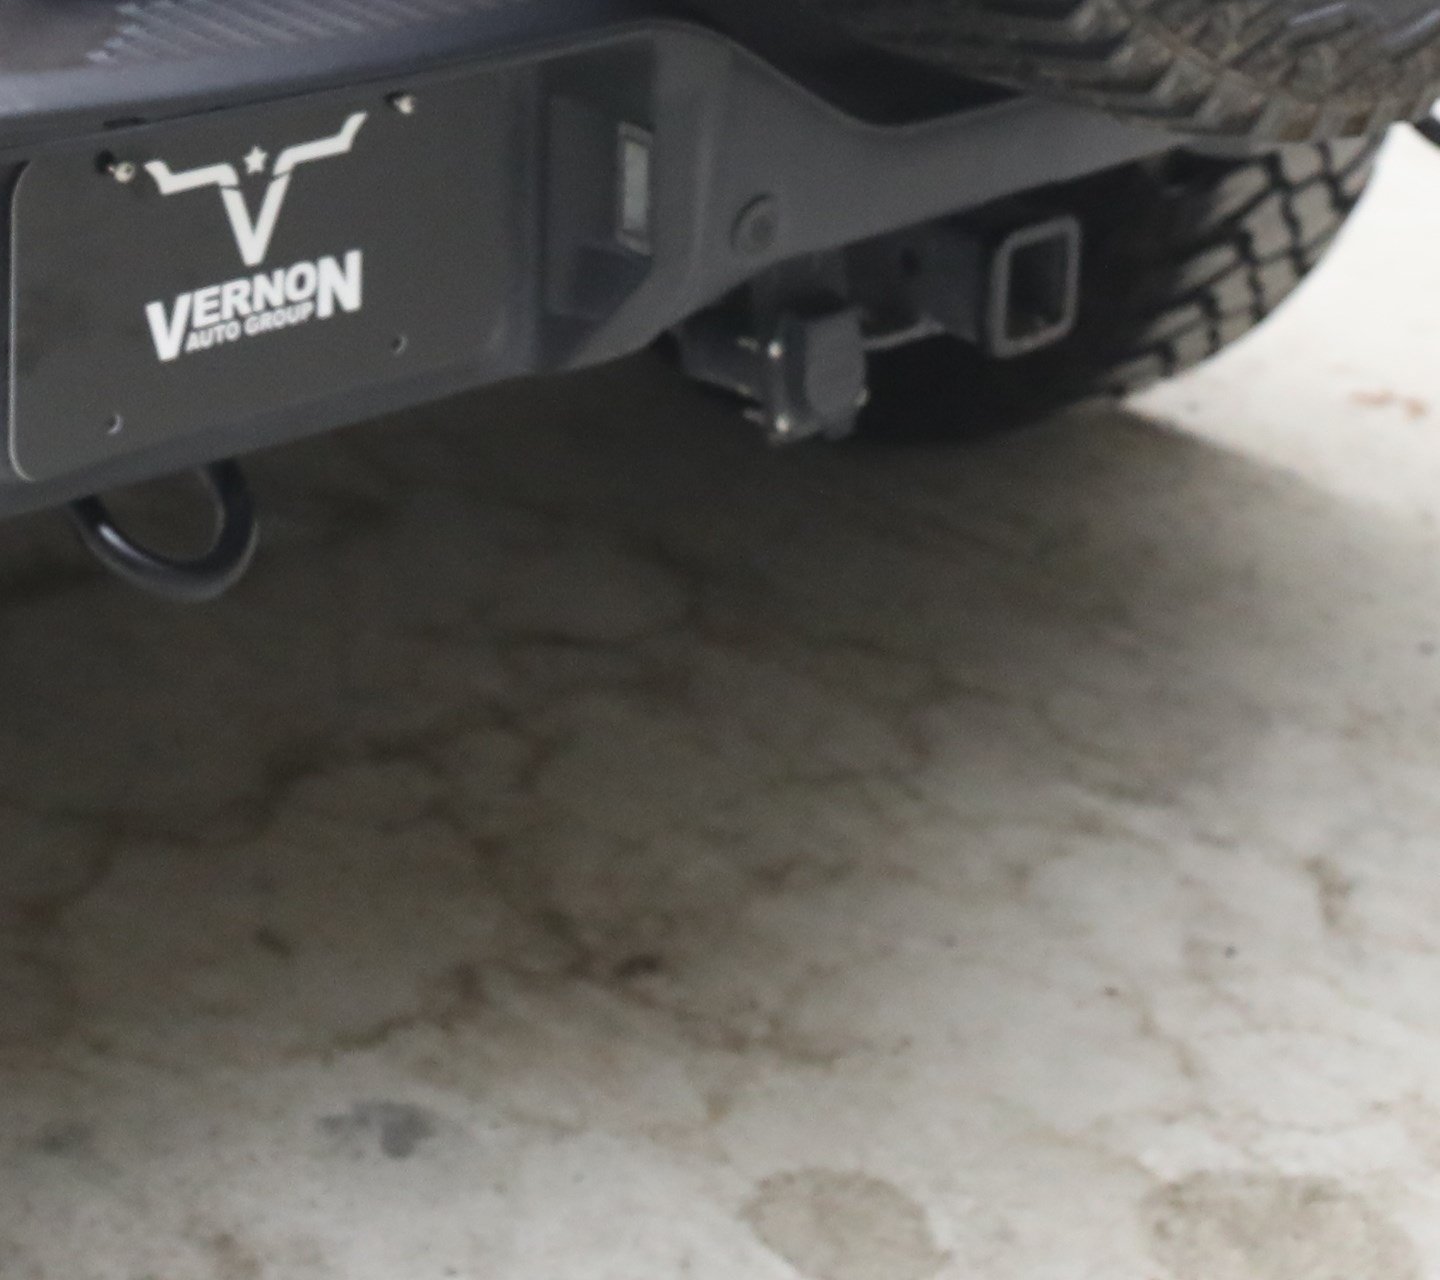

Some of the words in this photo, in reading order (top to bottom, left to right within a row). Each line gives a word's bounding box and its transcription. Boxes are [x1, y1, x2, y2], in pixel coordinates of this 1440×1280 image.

[145, 249, 363, 363] VERNON
[185, 320, 242, 354] AUTO
[243, 301, 314, 337] GROUP
